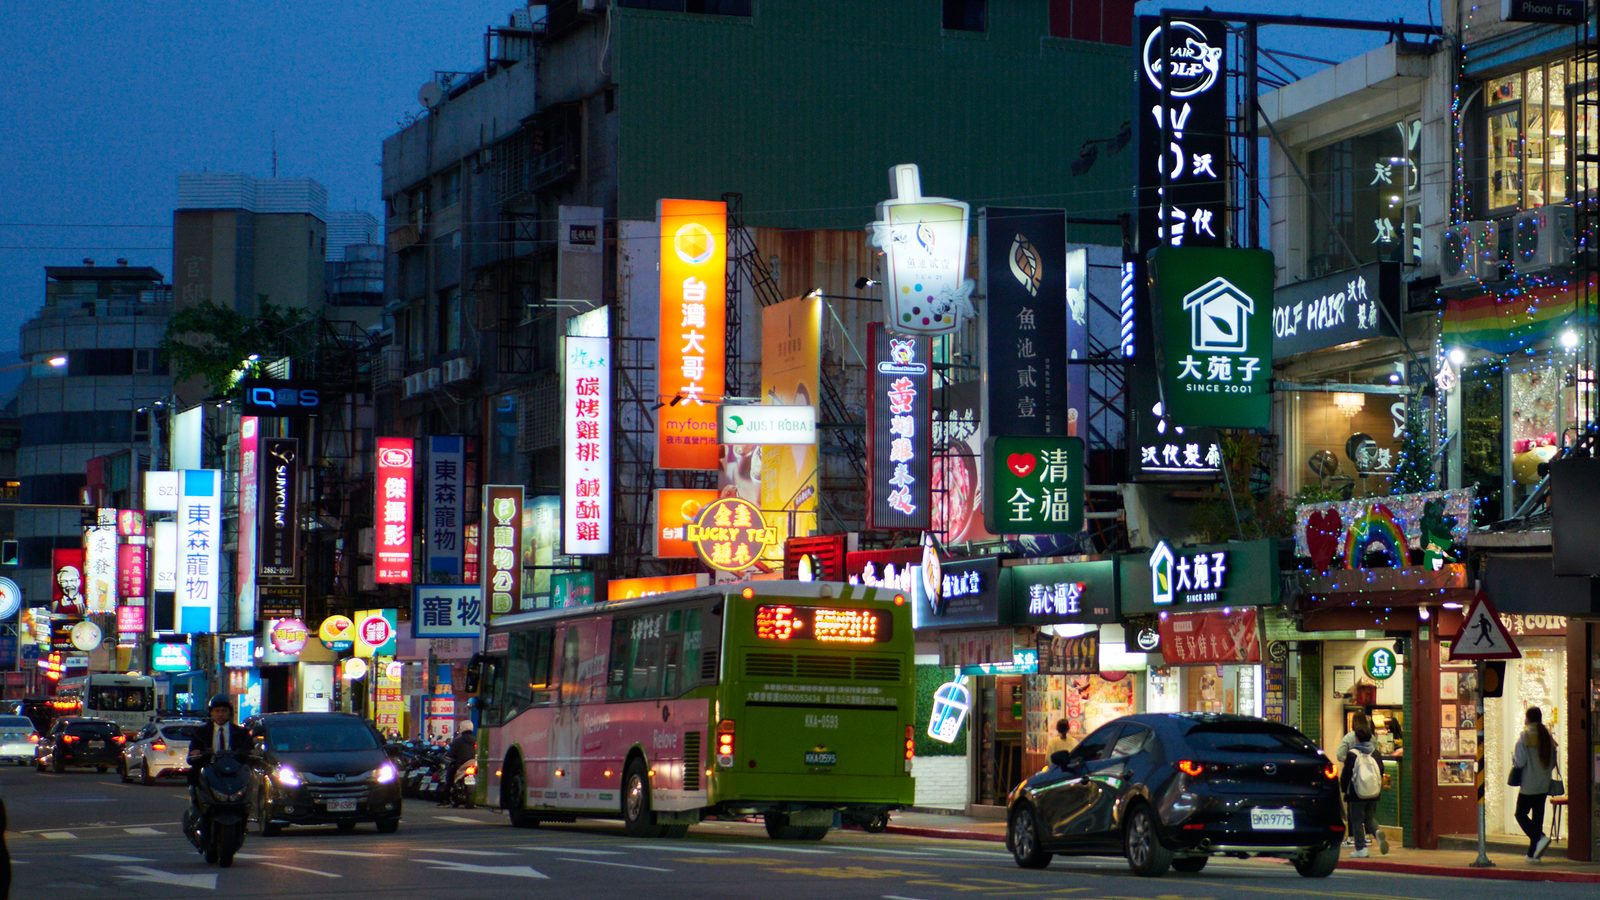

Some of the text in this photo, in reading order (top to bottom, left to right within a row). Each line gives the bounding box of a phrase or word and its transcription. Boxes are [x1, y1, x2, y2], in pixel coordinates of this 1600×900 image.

[1522, 2, 1573, 16] Phone Fix
[1273, 292, 1345, 337] OLF HAIR
[681, 277, 707, 406] 台灣大哥大
[1017, 307, 1037, 418] 魚池貳壹
[1177, 355, 1261, 381] 大苑子
[1186, 384, 1252, 393] SINCE 2001
[666, 418, 717, 432] myfone
[746, 420, 775, 432] JUST
[435, 460, 457, 551] 東森寵物
[689, 525, 775, 544] LUCKY TEA
[186, 504, 210, 600] 東森寵物
[492, 527, 515, 614] 寵物公園
[1176, 552, 1226, 591] 大苑子
[422, 595, 481, 627] 寵物
[1029, 583, 1080, 614] 清心福全
[1252, 813, 1293, 826] BKR-9775
